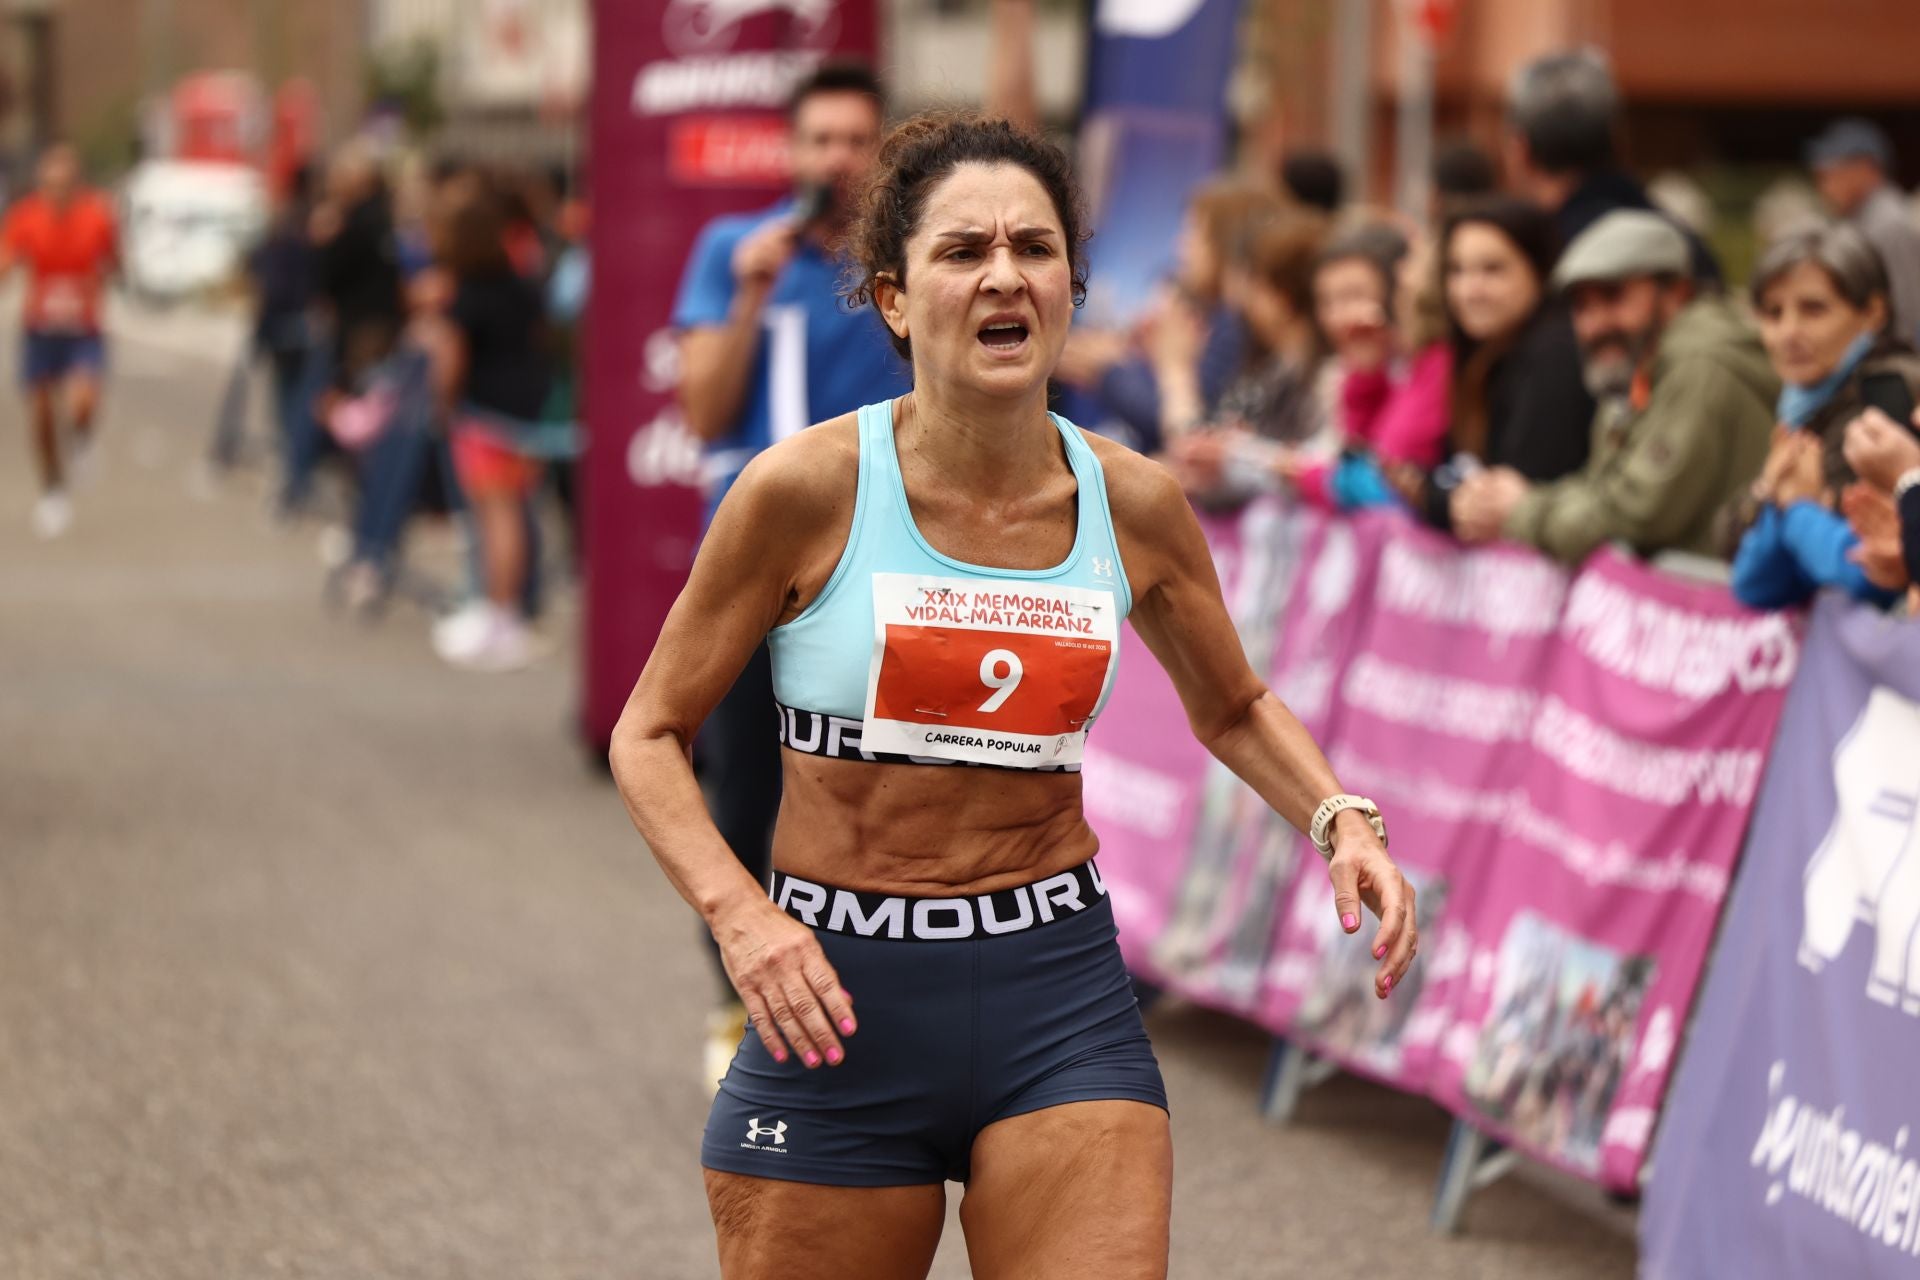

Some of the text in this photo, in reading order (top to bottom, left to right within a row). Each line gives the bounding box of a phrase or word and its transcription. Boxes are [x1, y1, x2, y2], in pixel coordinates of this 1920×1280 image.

[923, 589, 1074, 617] XXIX MEMORIAL
[905, 605, 1094, 634] VIDAL-MATARRANZ
[976, 648, 1024, 713] 9
[924, 732, 1042, 754] CARRERA POPULAR
[769, 871, 1087, 940] RMOUR
[740, 1142, 788, 1154] UNDER ARMOUR
